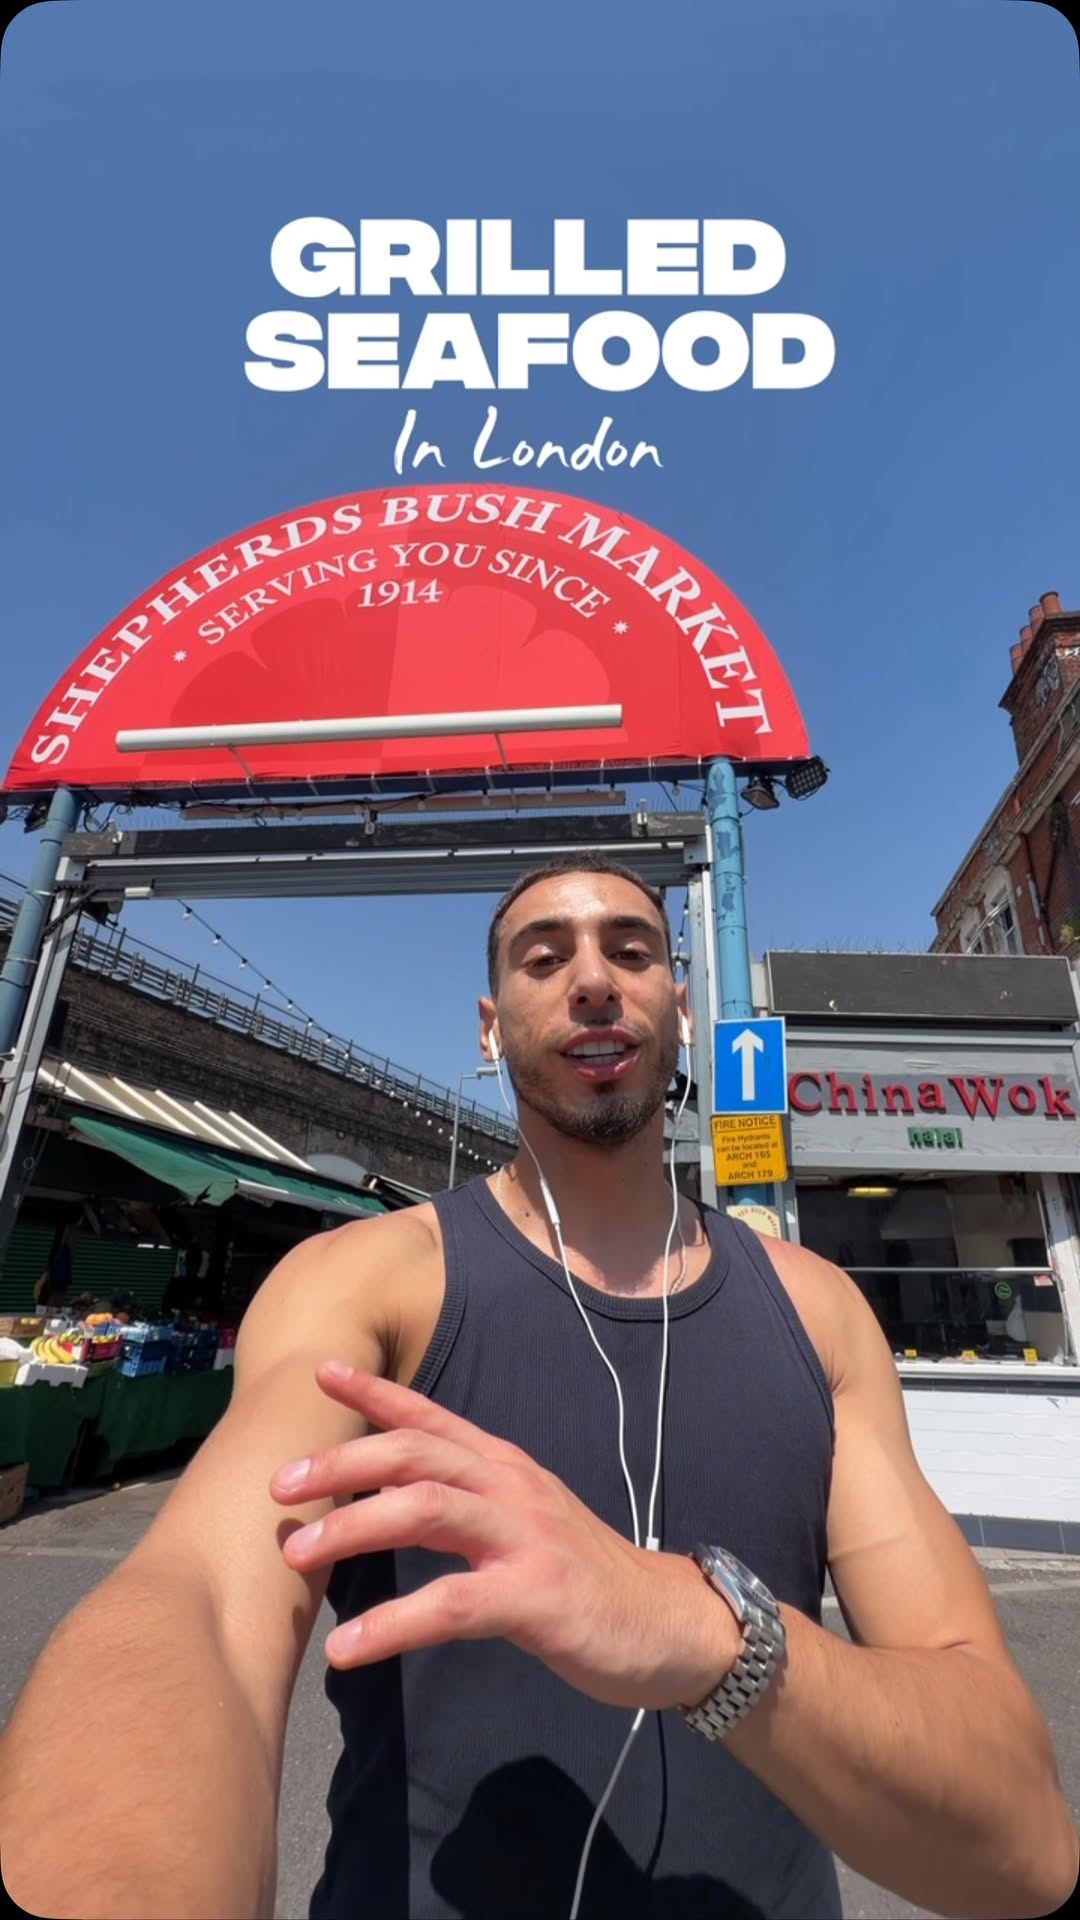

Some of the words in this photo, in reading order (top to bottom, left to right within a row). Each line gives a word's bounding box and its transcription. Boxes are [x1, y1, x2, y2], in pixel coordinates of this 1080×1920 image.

[198, 548, 378, 645] SERVING
[390, 542, 487, 568] YOU
[488, 549, 612, 618] SINCE
[357, 578, 444, 609] 1914
[30, 503, 363, 765] SHEPHERDS
[378, 493, 562, 534] BUSH
[557, 512, 773, 735] MARKET
[714, 1119, 736, 1130] FIRE
[738, 1116, 776, 1128] NOTICE
[726, 1151, 752, 1161] ARCH
[728, 1170, 754, 1180] ARCH
